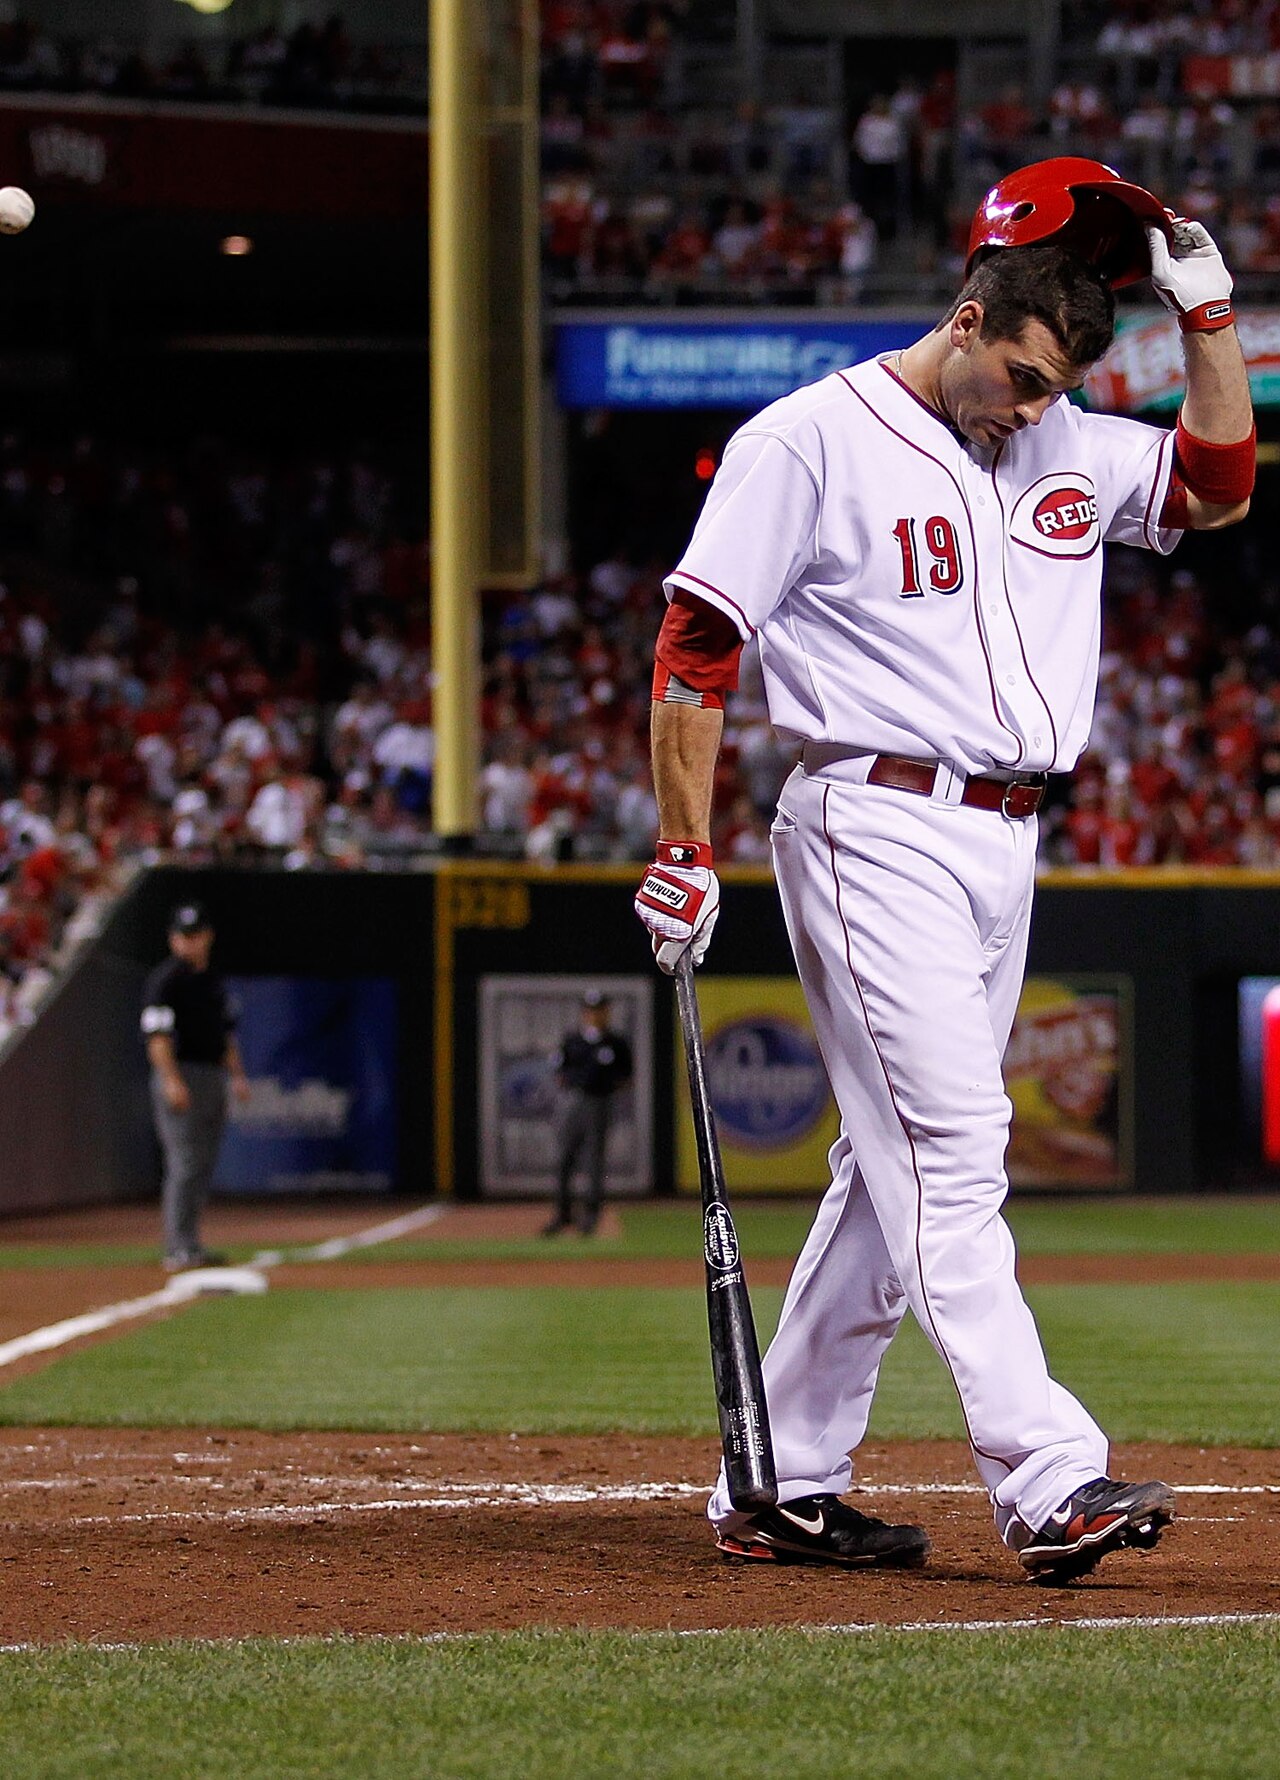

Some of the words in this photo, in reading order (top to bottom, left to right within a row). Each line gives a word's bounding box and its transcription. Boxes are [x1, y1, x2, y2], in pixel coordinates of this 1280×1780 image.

[1035, 496, 1099, 536] REDS
[891, 514, 964, 598] 19
[644, 878, 688, 907] Franklin
[708, 1216, 722, 1261] Slugger
[716, 1208, 736, 1266] Louisville
